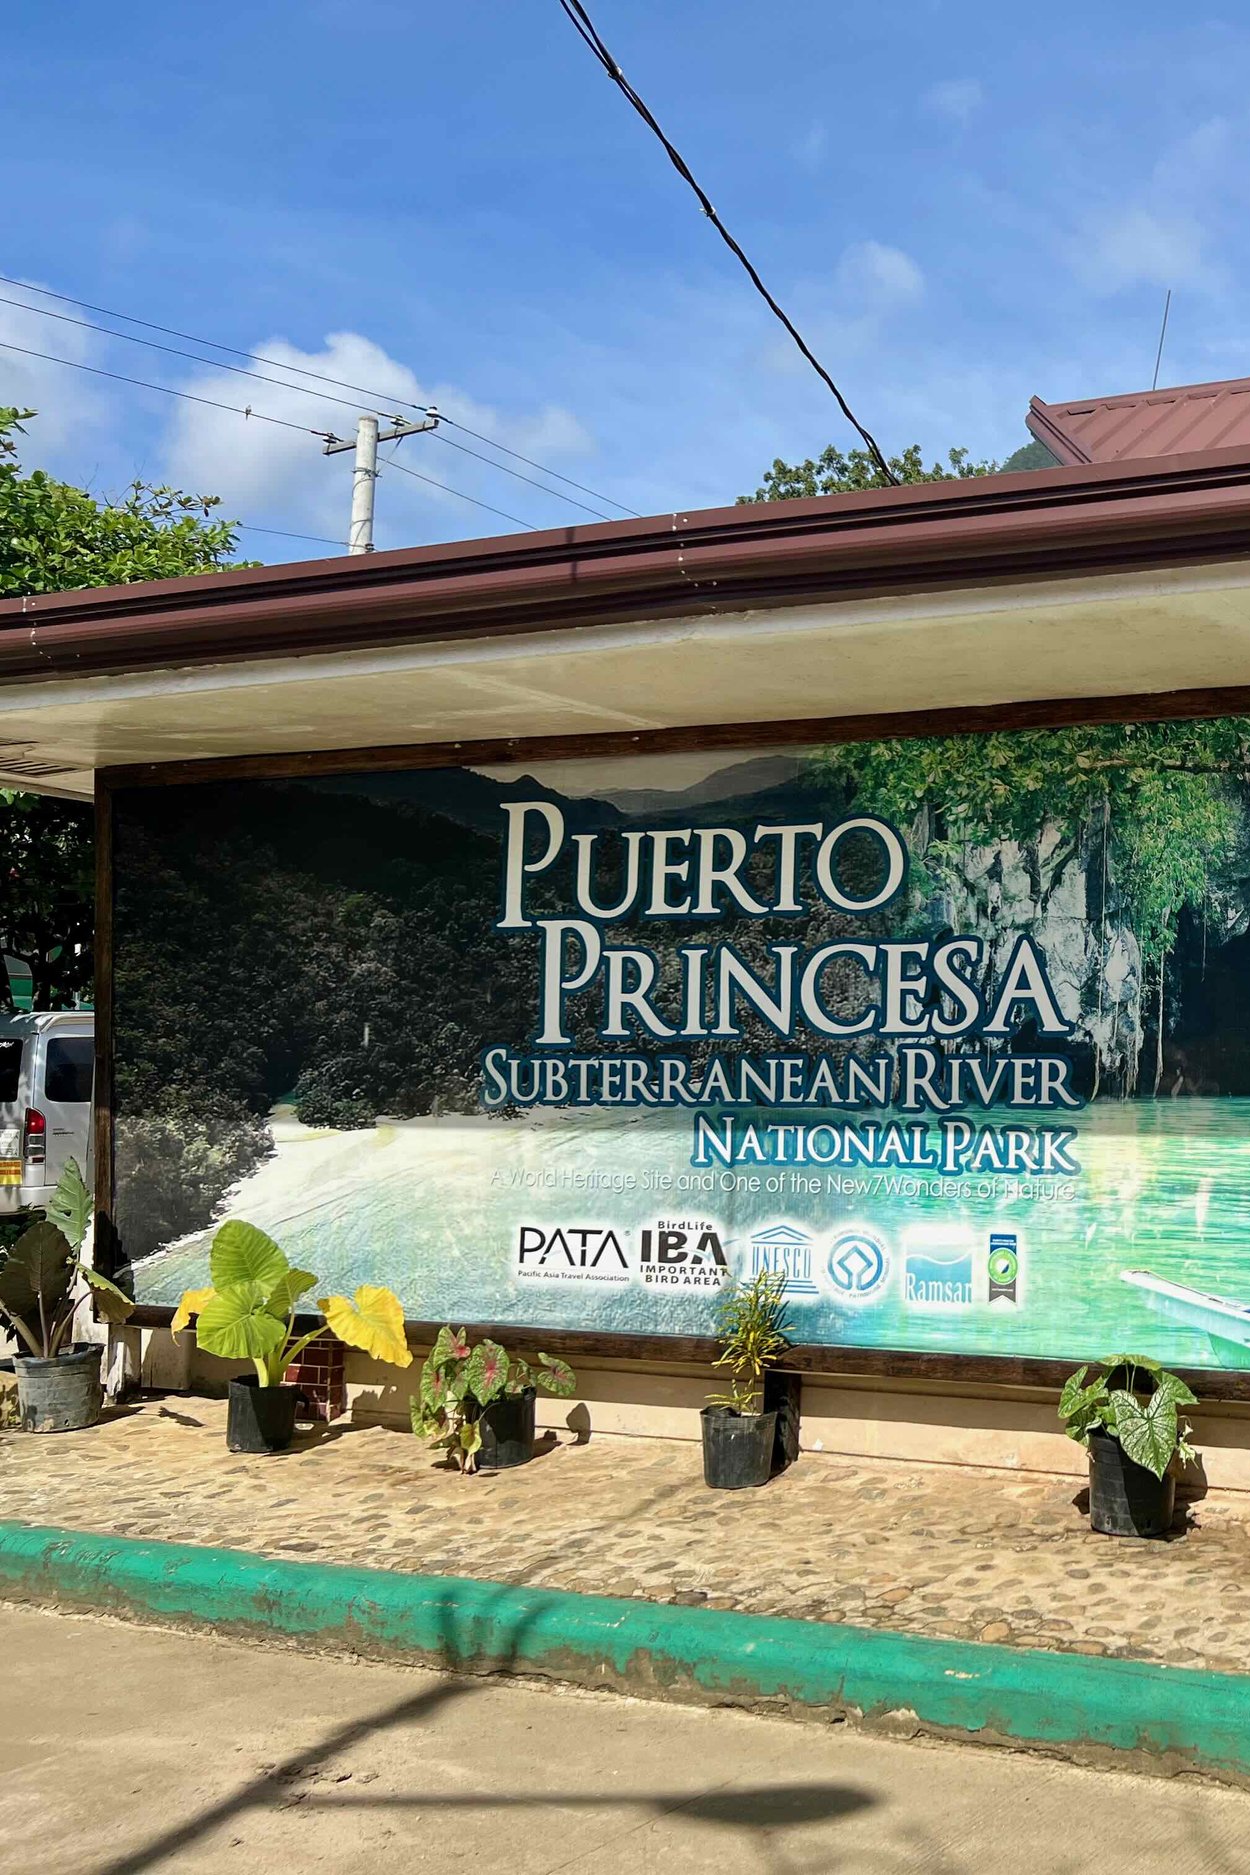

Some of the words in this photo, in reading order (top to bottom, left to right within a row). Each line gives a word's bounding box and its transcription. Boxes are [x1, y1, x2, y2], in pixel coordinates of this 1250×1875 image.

[496, 801, 905, 929] PUERTO
[534, 918, 1071, 1045] PRINCESA
[484, 1047, 888, 1105] SUBTERRANEAN
[901, 1048, 1080, 1110] RIVER
[693, 1115, 933, 1166] NATIONAL
[938, 1121, 1079, 1173] PARK
[490, 1170, 504, 1186] A
[509, 1169, 557, 1187] World
[561, 1171, 636, 1193] Heritage
[642, 1170, 675, 1191] Site
[678, 1171, 716, 1192] and
[720, 1172, 761, 1193] One
[766, 1173, 788, 1193] of
[790, 1173, 822, 1194] the
[978, 1178, 999, 1199] of
[1005, 1180, 1076, 1201] Nature
[657, 1220, 713, 1231] BirdLife
[518, 1226, 630, 1269] PATA
[640, 1229, 728, 1267] IBA
[751, 1245, 812, 1279] UNESCO
[517, 1269, 541, 1278] Pacific
[543, 1271, 560, 1279] Asia
[561, 1272, 584, 1280] Travel
[585, 1273, 630, 1282] Association
[640, 1264, 729, 1277] IMPORTANT
[645, 1275, 680, 1285] BIRD
[683, 1276, 722, 1287] AREA
[905, 1272, 973, 1303] Ramsar
